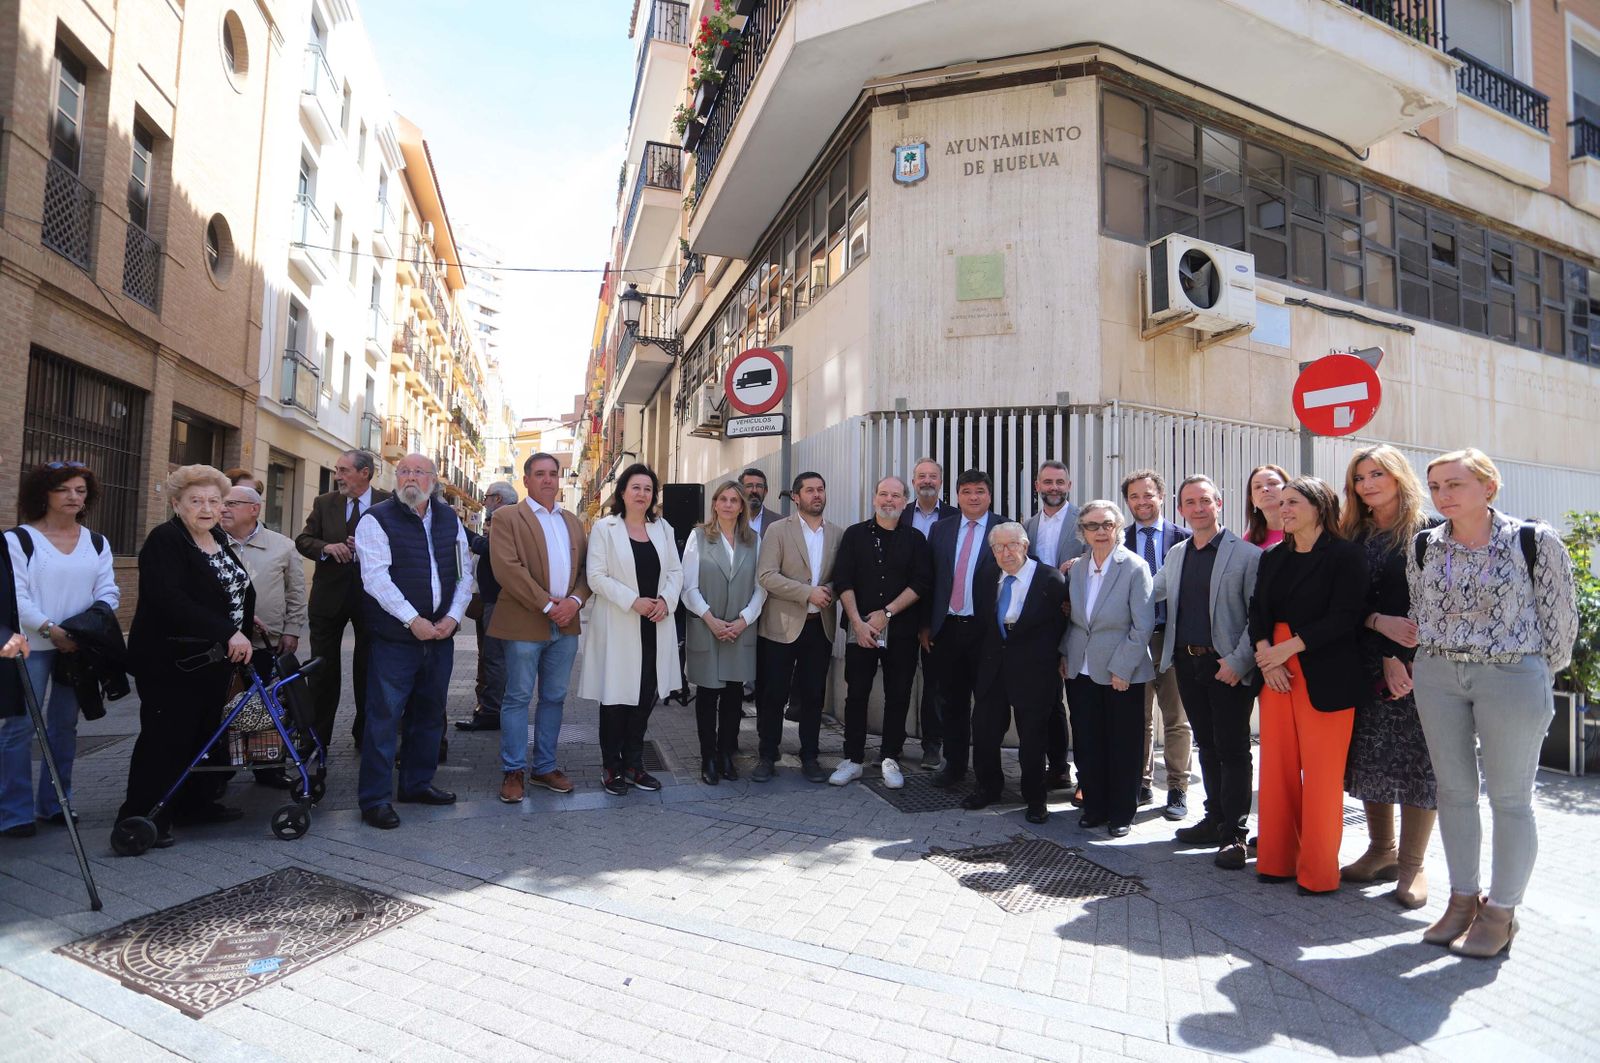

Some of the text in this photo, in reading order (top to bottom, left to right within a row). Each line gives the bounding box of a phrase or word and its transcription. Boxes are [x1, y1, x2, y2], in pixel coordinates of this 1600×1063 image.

[945, 126, 1081, 156] AYUNTAMIENTO
[964, 152, 1060, 176] DE HUELVA
